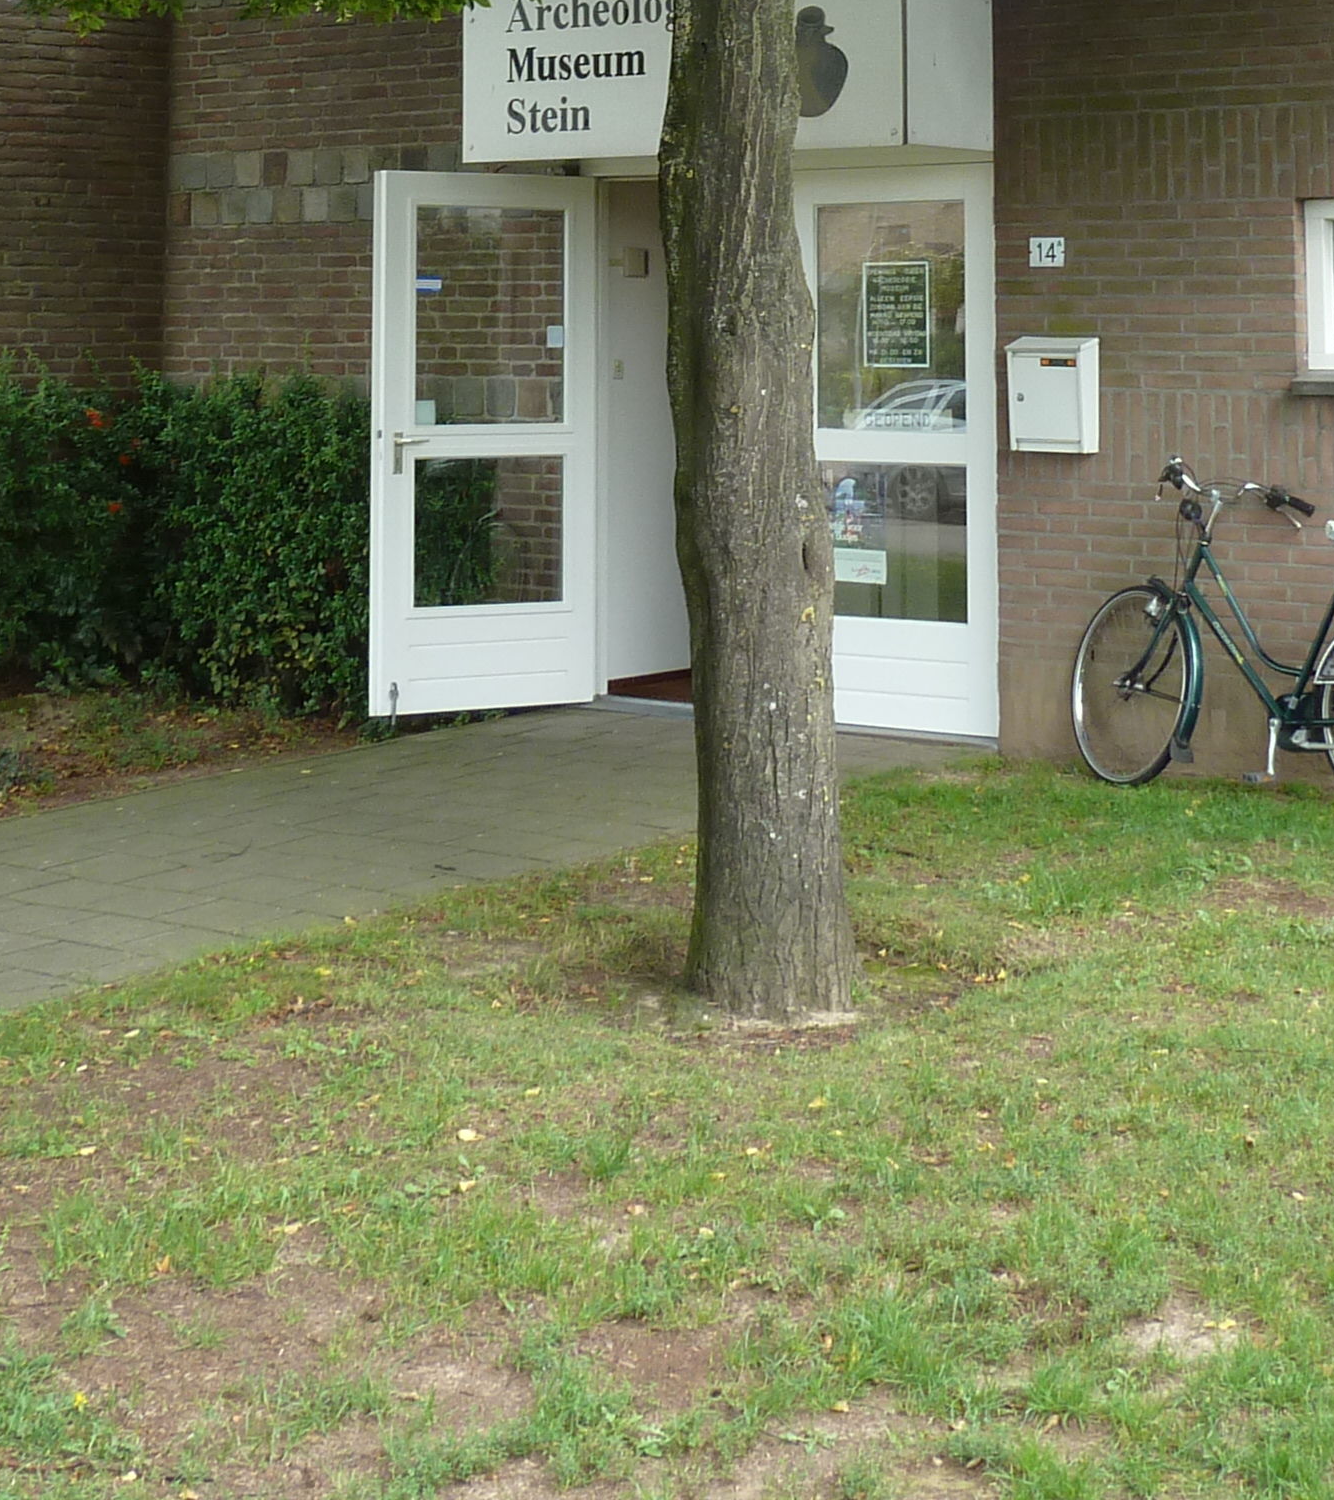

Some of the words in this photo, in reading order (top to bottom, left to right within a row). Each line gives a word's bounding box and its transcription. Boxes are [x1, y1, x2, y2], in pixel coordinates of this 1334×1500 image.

[506, 46, 646, 83] Museum
[507, 96, 591, 135] Stein
[864, 412, 931, 428] GEOPEND
